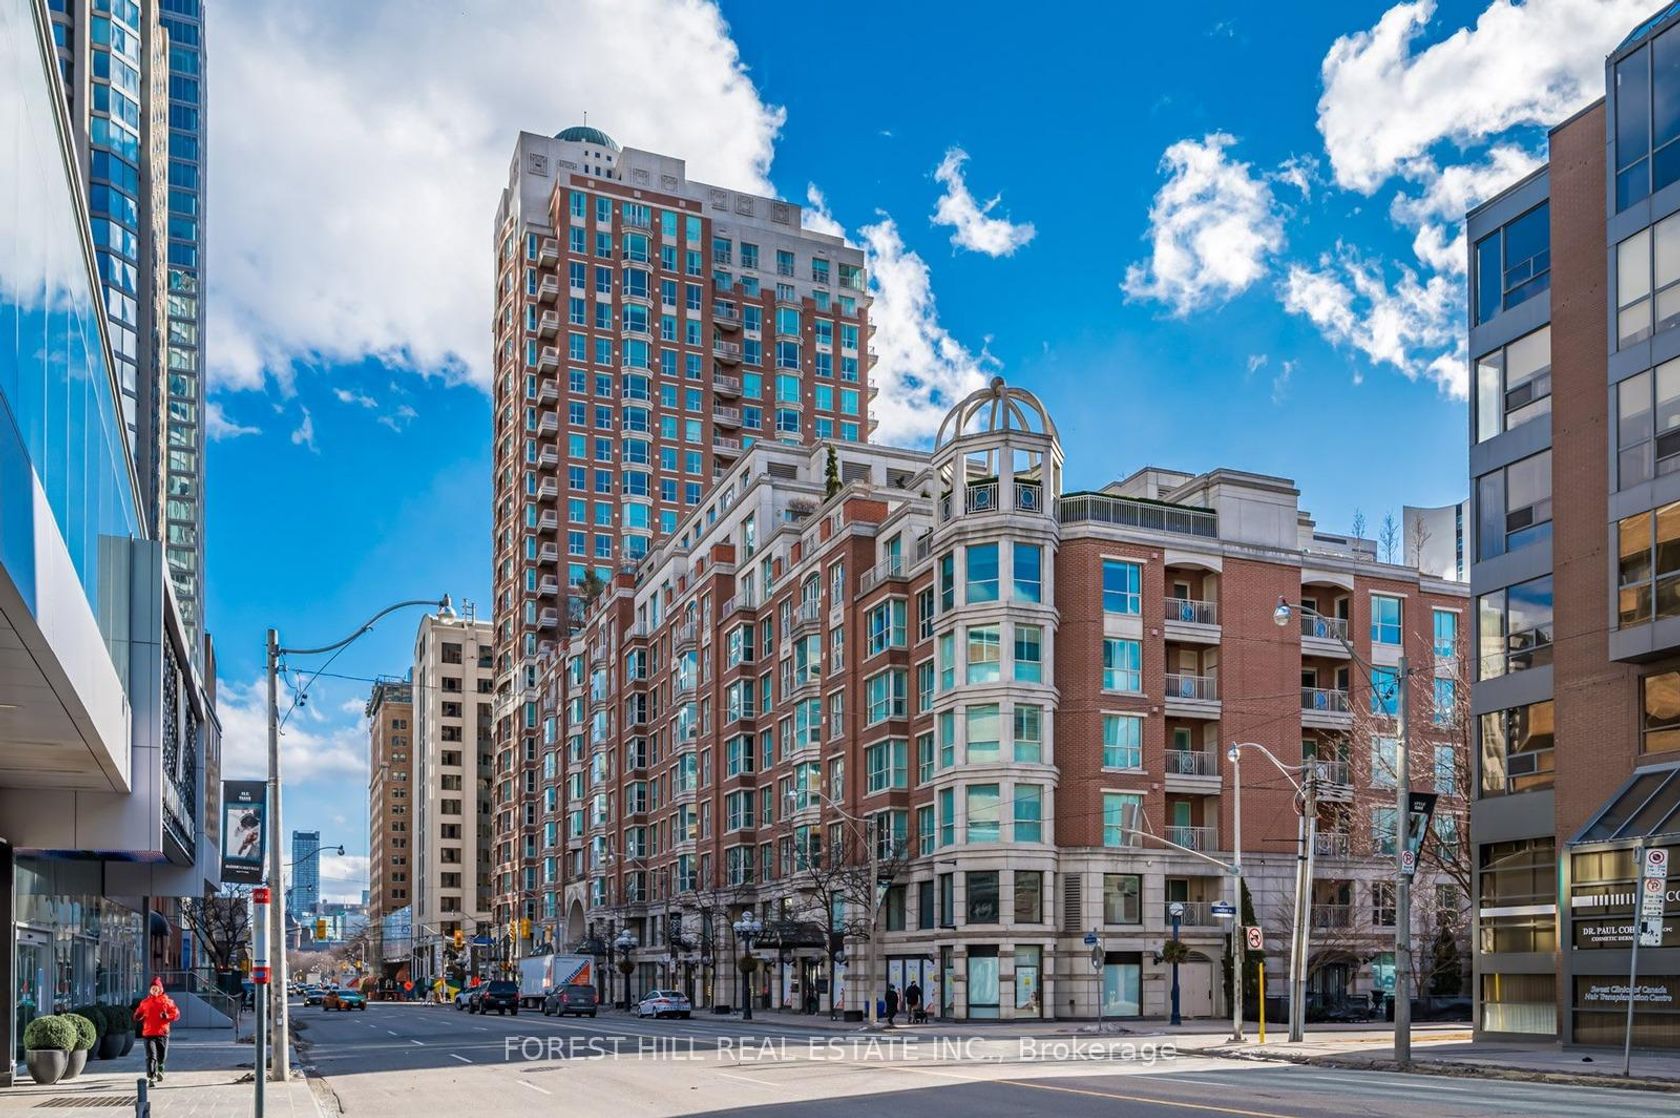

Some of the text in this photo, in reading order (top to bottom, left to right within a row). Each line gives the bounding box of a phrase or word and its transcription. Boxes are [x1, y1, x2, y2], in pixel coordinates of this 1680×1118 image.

[1583, 927, 1596, 935] DR.
[1597, 926, 1617, 934] PAUL
[1600, 993, 1649, 1002] Transplanation
